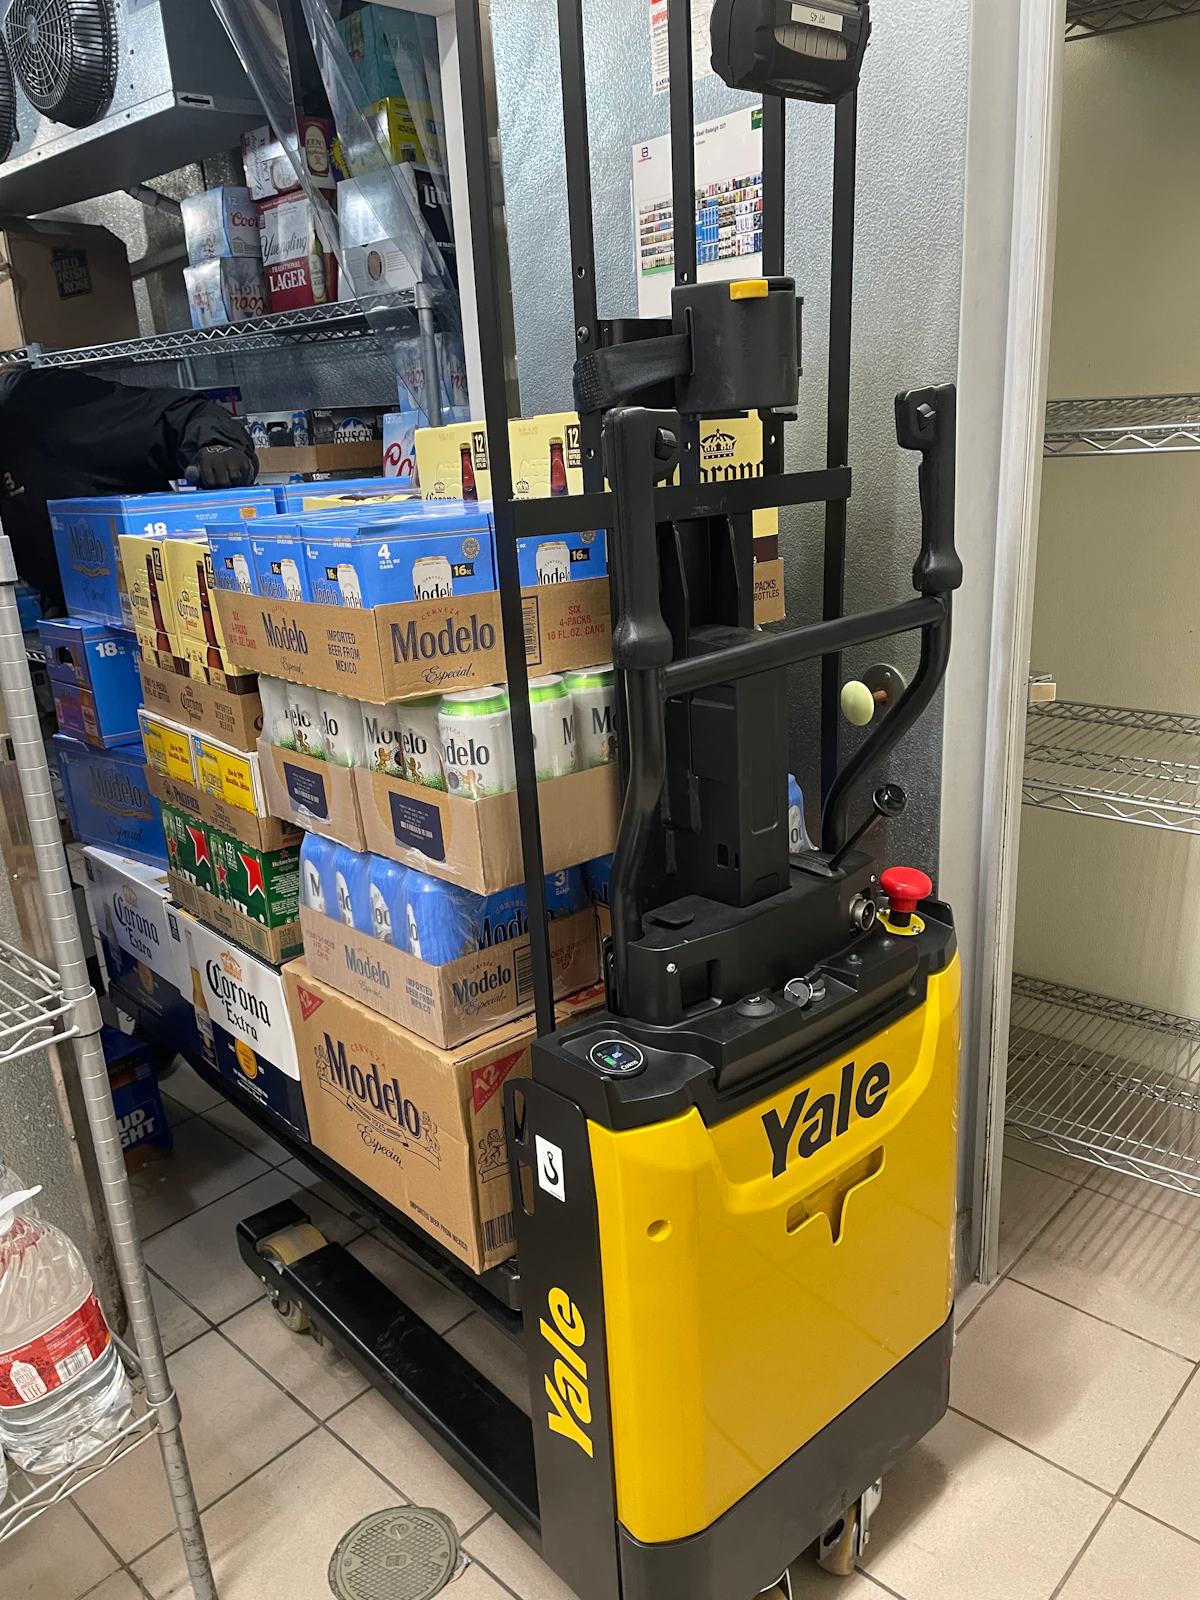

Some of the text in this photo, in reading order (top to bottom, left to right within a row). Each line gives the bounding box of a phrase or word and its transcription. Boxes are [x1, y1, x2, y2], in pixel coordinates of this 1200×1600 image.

[818, 14, 826, 24] RT
[696, 124, 719, 138] East Raleigh
[259, 232, 308, 264] Yuengling
[51, 258, 79, 272] WILD
[271, 261, 302, 274] TRADITIONAL
[59, 267, 88, 283] IRISH
[269, 269, 307, 293] LAGER
[63, 279, 91, 294] ROSE
[314, 410, 322, 418] 12
[334, 428, 374, 444] BUSCH
[474, 434, 485, 453] 12
[568, 427, 579, 448] 12
[312, 473, 321, 481] 12
[144, 522, 167, 535] 18
[69, 525, 104, 564] Modelo
[378, 543, 391, 560] 4
[154, 550, 160, 566] 12
[313, 581, 339, 605] Modelo
[755, 579, 776, 592] PACKS
[130, 589, 149, 609] Corona
[753, 589, 780, 601] BOTTLES
[177, 598, 199, 620] Corona
[421, 606, 460, 620] CERVEZA
[568, 604, 581, 615] SIX
[559, 615, 592, 628] 4-PACKS
[260, 612, 309, 655] Modelo
[326, 629, 356, 645] IMPORTED
[390, 613, 495, 664] Modelo
[546, 631, 556, 641] 16
[584, 623, 605, 635] CANS
[95, 641, 118, 658] 18
[327, 643, 361, 661] BEER FROM
[335, 659, 357, 675] MEXICO
[180, 692, 204, 714] Corona
[88, 765, 143, 808] Modelo
[175, 816, 182, 827] 12
[225, 841, 233, 853] 12
[271, 856, 299, 868] Heineken
[555, 871, 566, 887] 3
[113, 892, 160, 946] Corona
[126, 927, 152, 960] Extra
[550, 947, 565, 959] OUR
[343, 944, 391, 989] Modelo
[469, 961, 494, 975] CERVEZA
[206, 959, 272, 1028] Corona
[405, 976, 433, 997] IMPORTED
[452, 965, 513, 1008] Modelo
[301, 990, 313, 1010] 12
[405, 985, 436, 1008] BEER FROM
[410, 996, 432, 1015] MEXICO
[221, 998, 259, 1042] Extra
[350, 1042, 387, 1071] CERVEZA
[322, 1031, 421, 1138] Modelo
[474, 1064, 500, 1092] 12
[116, 1109, 146, 1133] UD
[371, 1117, 386, 1132] 1925
[760, 1060, 890, 1180] Yale
[120, 1116, 155, 1149] GHT
[409, 1199, 468, 1252] IMPORTED BEER FROM MEXICO
[539, 1286, 594, 1459] Yale
[23, 1384, 43, 1401] LIFE
